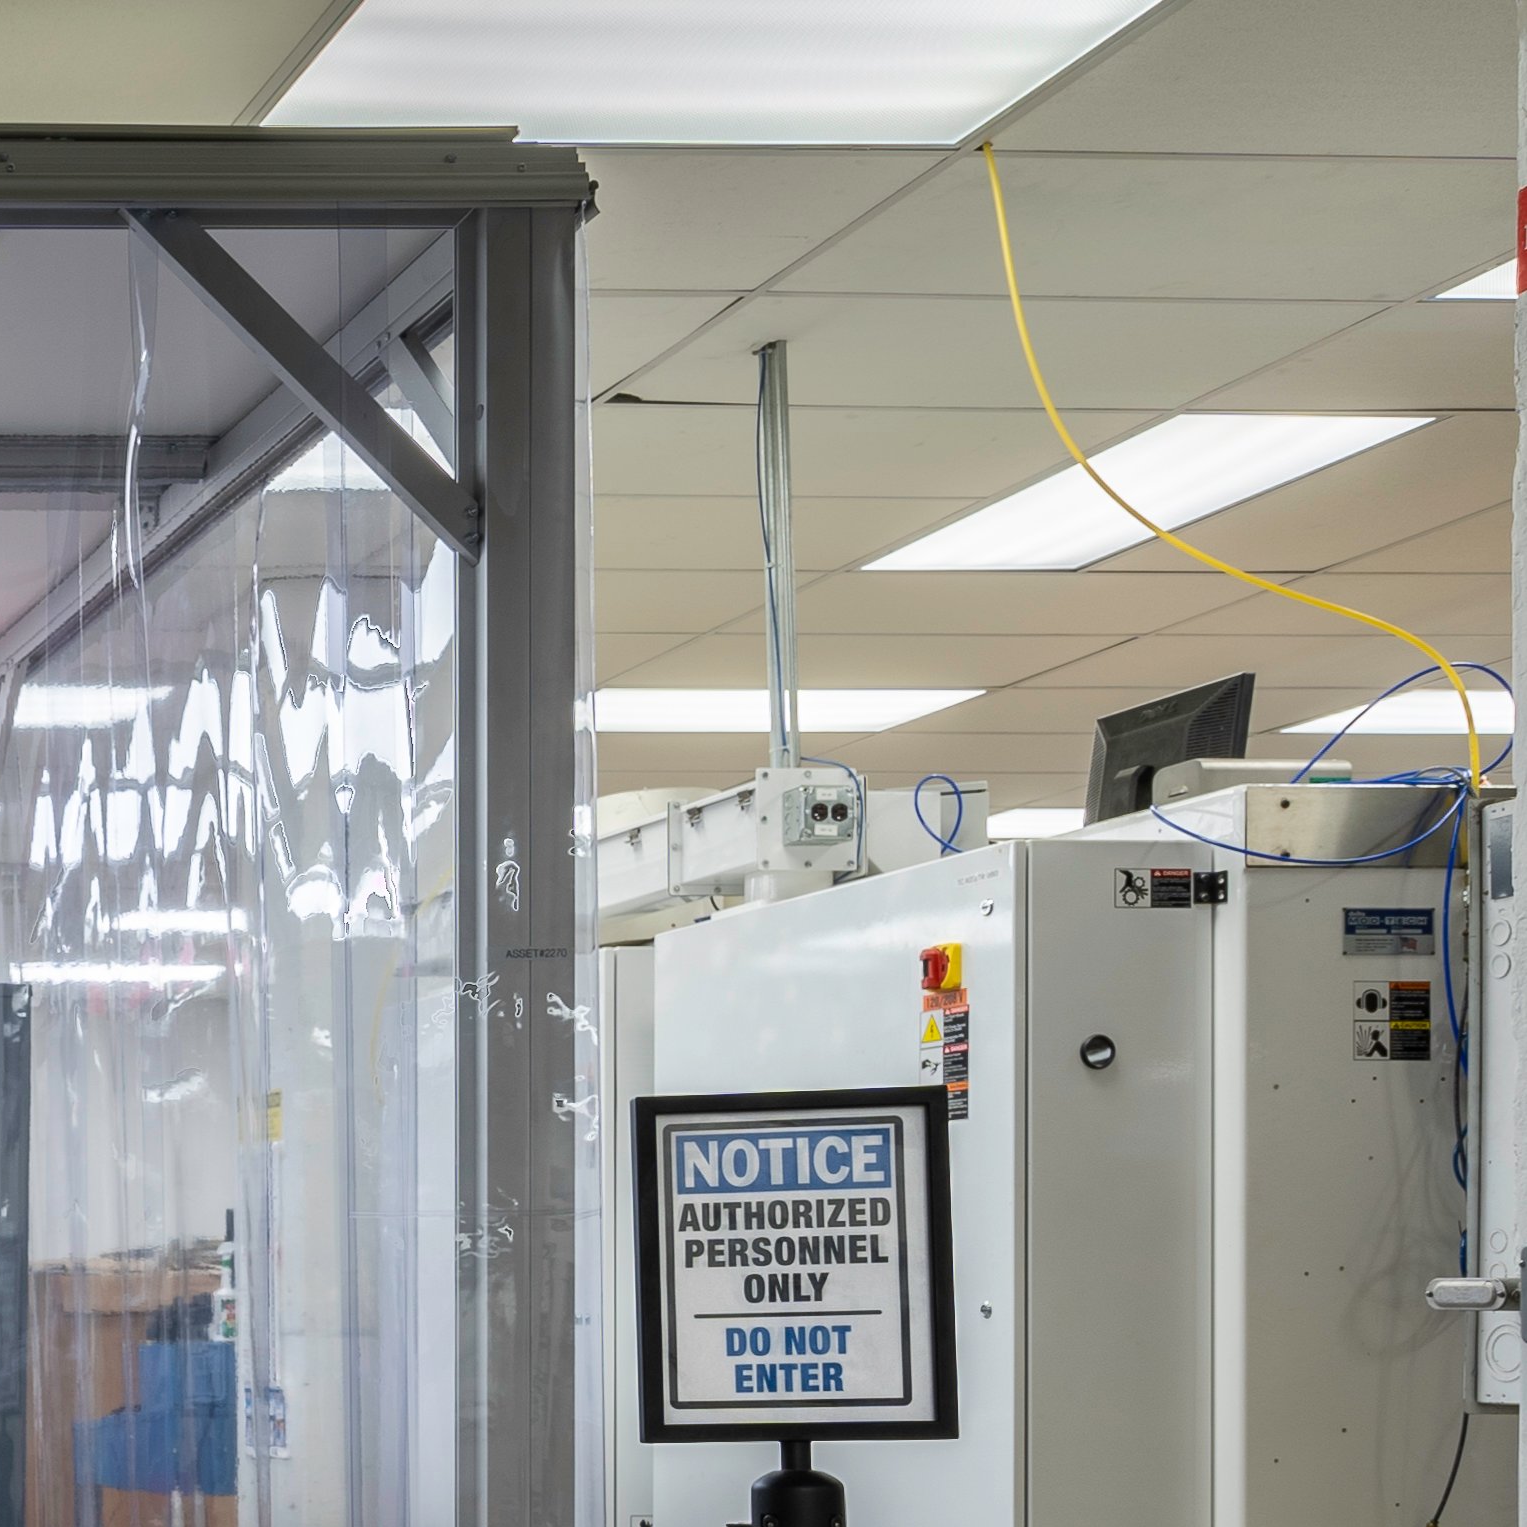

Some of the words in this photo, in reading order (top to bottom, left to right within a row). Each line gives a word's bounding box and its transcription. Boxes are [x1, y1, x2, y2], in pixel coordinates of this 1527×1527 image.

[505, 947, 568, 959] ASSET#2270
[682, 1134, 887, 1189] NOTICE
[677, 1196, 892, 1232] AUTHORIZED
[683, 1234, 889, 1269] PERSONNEL
[743, 1272, 830, 1304] ONLY
[725, 1327, 771, 1357] DO
[784, 1325, 852, 1355] NOT
[734, 1362, 845, 1394] ENTER
